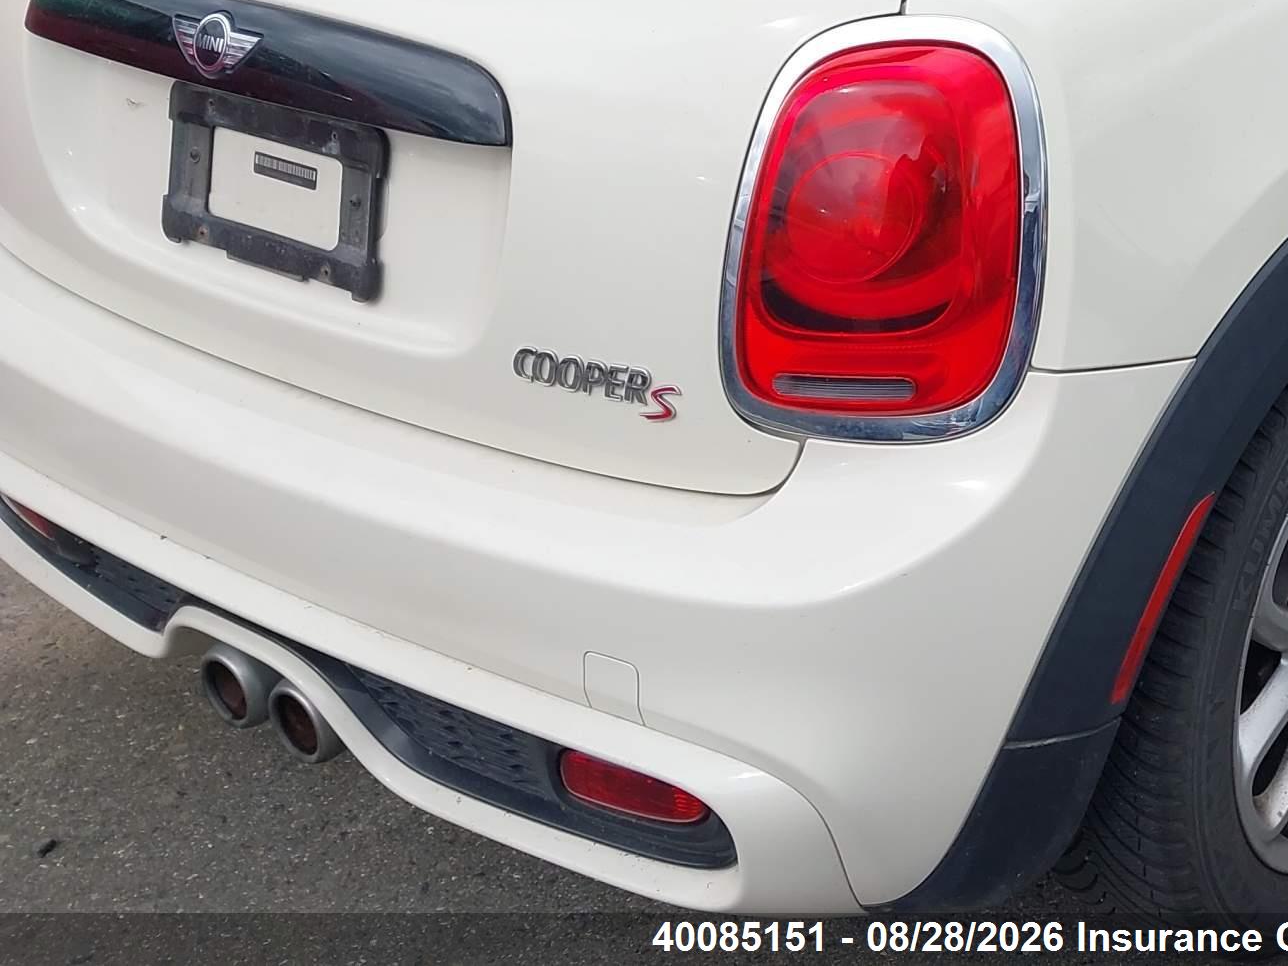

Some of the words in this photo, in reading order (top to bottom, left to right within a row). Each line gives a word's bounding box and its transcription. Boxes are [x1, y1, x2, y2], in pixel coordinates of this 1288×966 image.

[197, 33, 224, 54] MINI
[512, 345, 652, 407] COOPER
[639, 384, 682, 422] S
